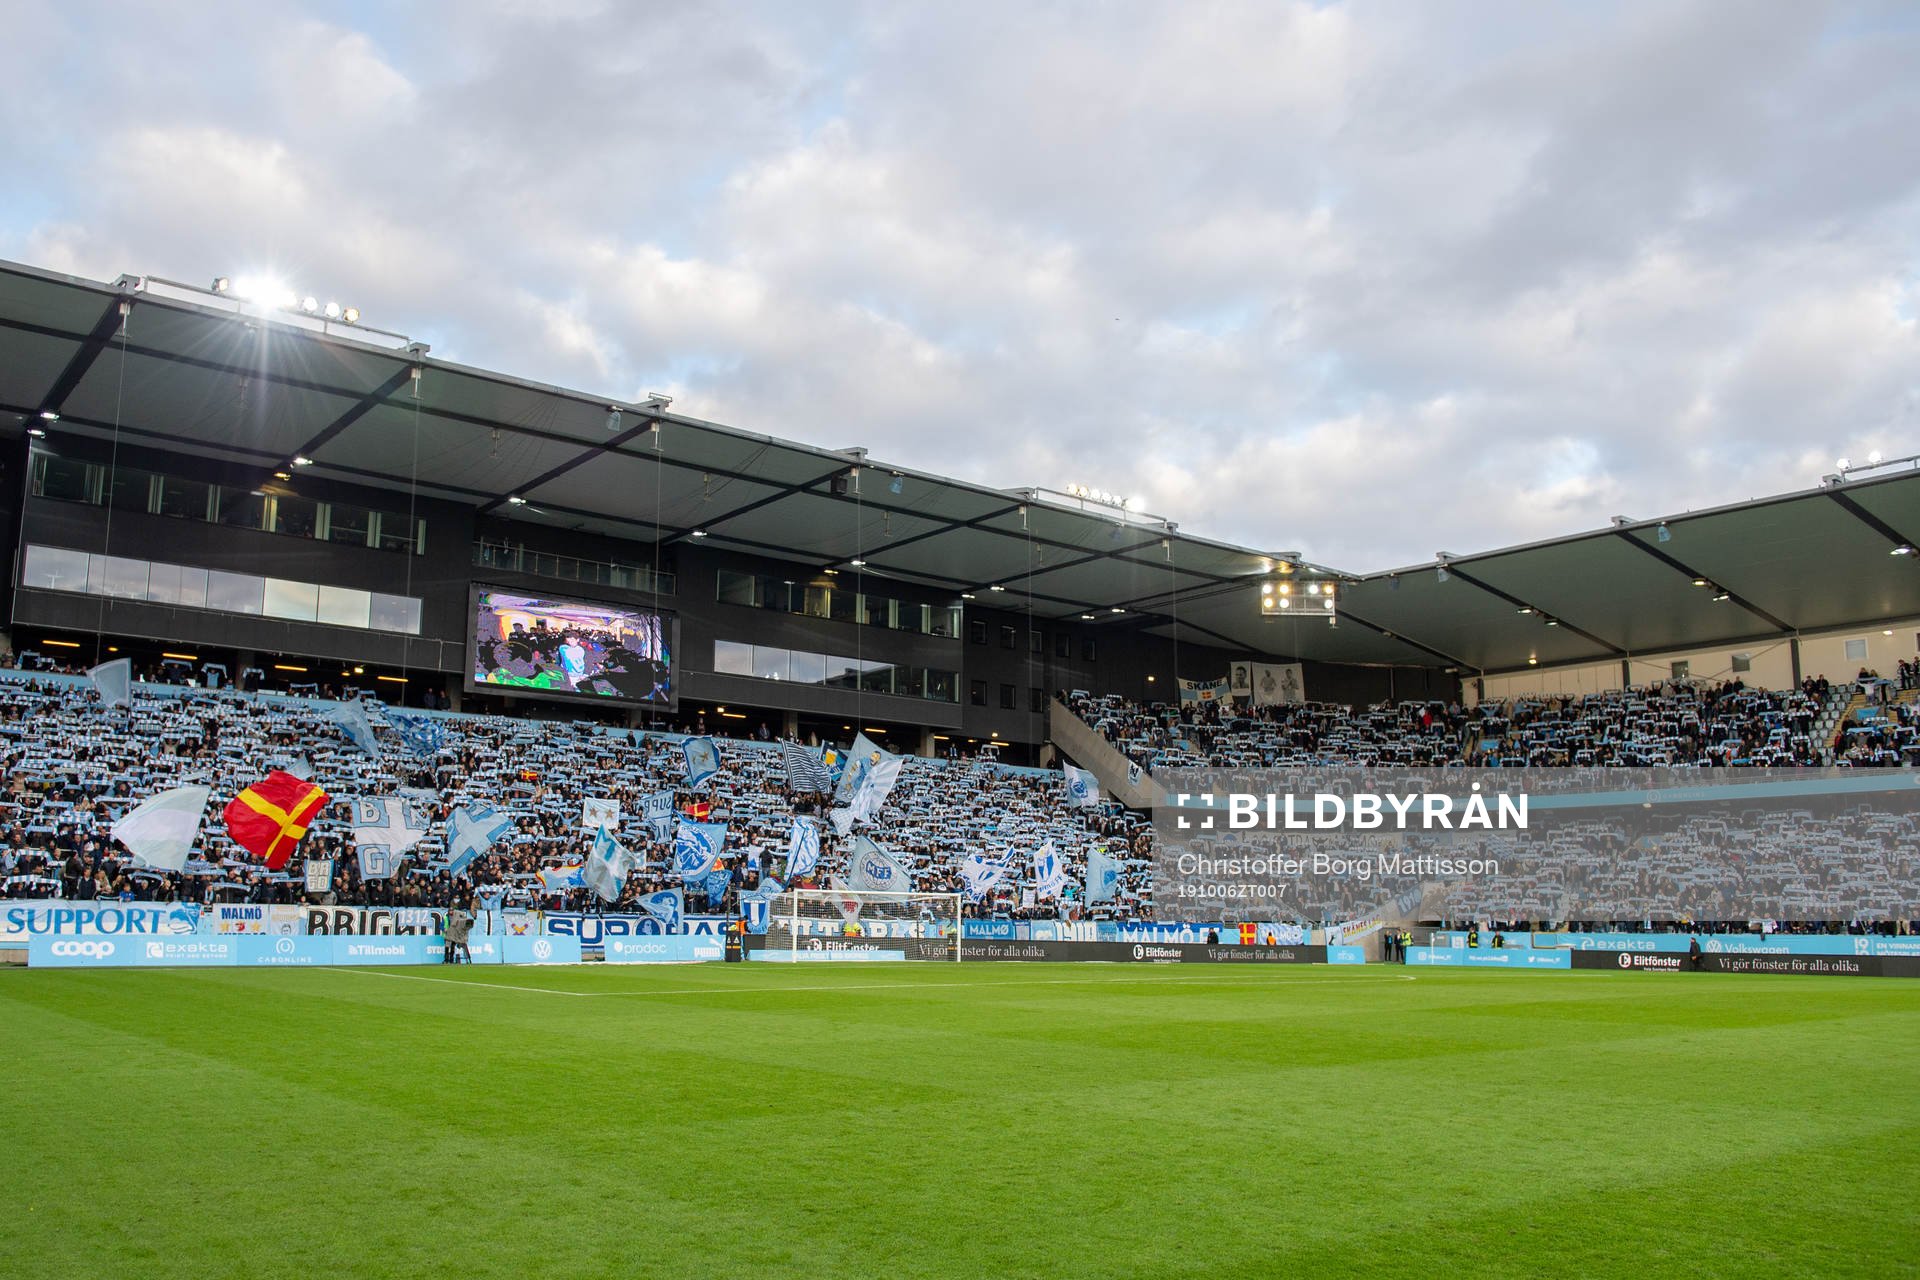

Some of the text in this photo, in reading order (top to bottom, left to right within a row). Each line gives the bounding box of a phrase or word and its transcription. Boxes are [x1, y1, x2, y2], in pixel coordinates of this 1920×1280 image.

[221, 906, 262, 920] MALMÖ
[400, 910, 429, 924] 1312
[6, 908, 166, 934] SUPPORT
[969, 925, 1009, 936] MALMØ
[1122, 924, 1194, 943] MALMÖ
[51, 940, 115, 959] coop
[166, 941, 228, 953] exakta
[987, 944, 1001, 956] för
[1003, 945, 1019, 957] alla
[1022, 946, 1045, 957] olika
[1596, 940, 1656, 950] exakta
[1725, 943, 1790, 954] Volkswagen
[1145, 946, 1182, 958] Elitfönster
[1208, 949, 1218, 958] Vi
[1220, 949, 1229, 961] gör
[1230, 949, 1254, 960] fönster
[1266, 950, 1277, 959] alla
[1278, 950, 1295, 960] olika
[1633, 954, 1681, 967] Elitfönster
[1719, 958, 1859, 972] Vi gör fönster för alla olika
